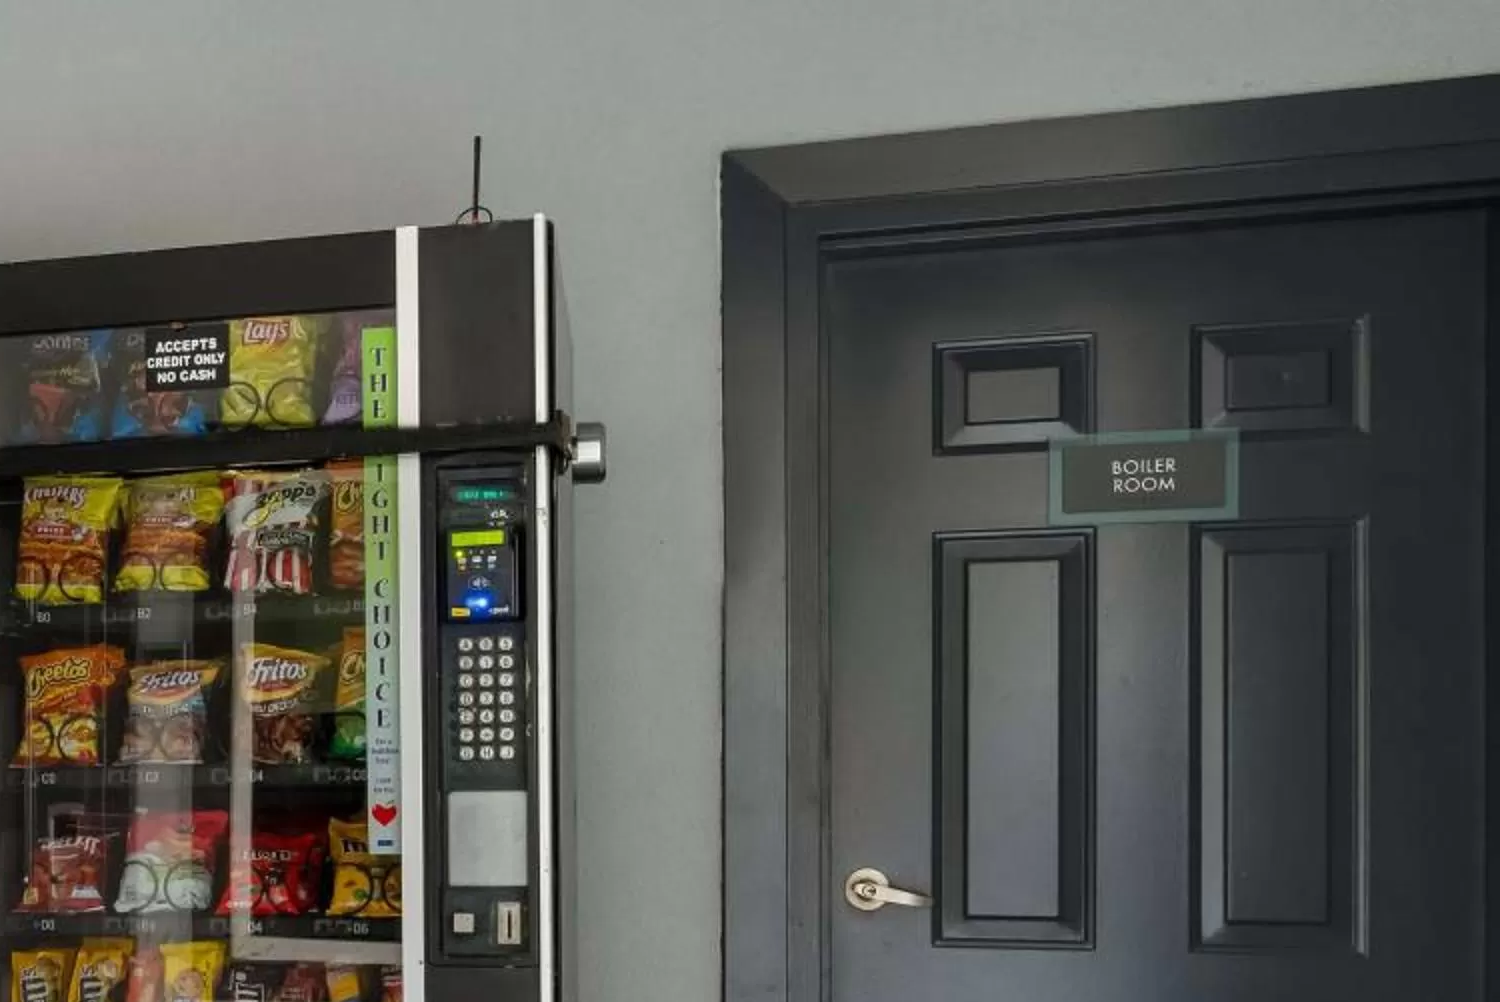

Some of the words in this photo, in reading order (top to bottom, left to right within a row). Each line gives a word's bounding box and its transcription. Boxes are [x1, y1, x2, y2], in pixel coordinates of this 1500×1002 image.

[155, 337, 218, 353] ACCEPTS
[147, 355, 190, 370] CREDIT
[194, 351, 226, 366] ONLY
[157, 371, 177, 384] NO
[180, 368, 217, 382] CASH
[370, 347, 389, 420] THE
[1111, 457, 1177, 475] BOILER
[1113, 476, 1176, 493] ROOM
[372, 462, 390, 561] IGHT
[372, 578, 392, 729] CHOICE
[28, 658, 92, 699] Cheetos
[141, 670, 200, 690] Fritos
[250, 656, 307, 684] Fritos
